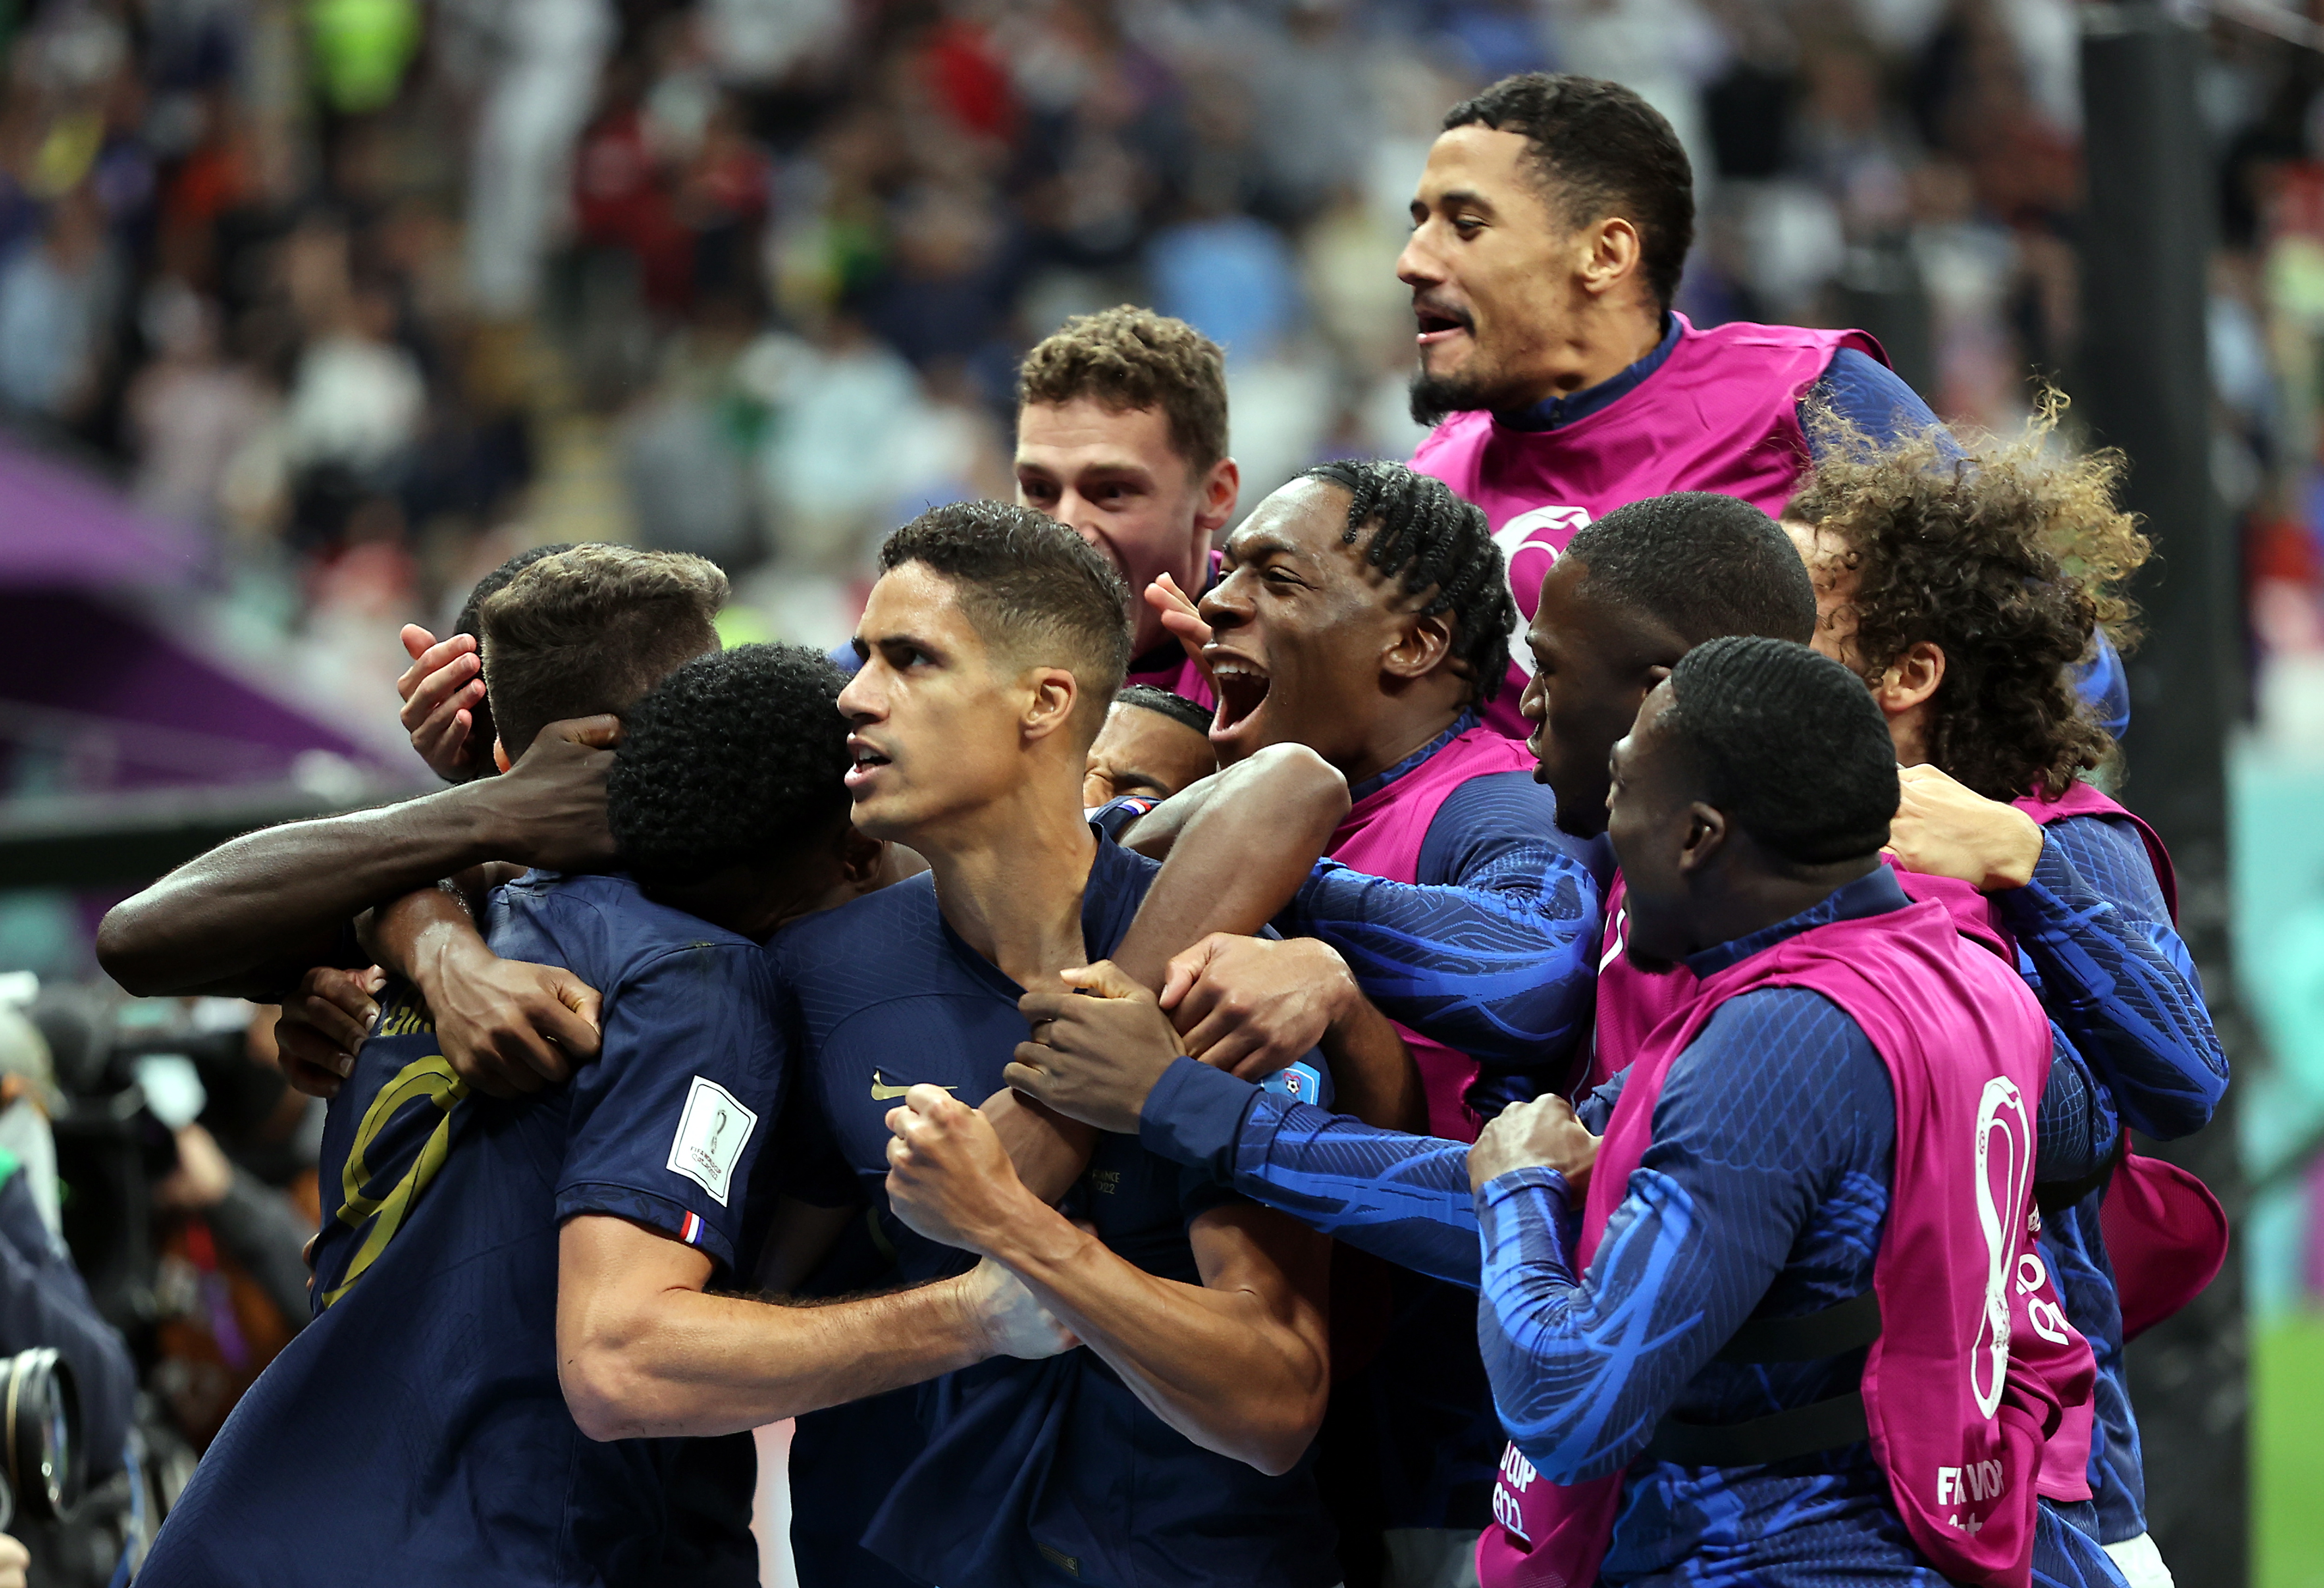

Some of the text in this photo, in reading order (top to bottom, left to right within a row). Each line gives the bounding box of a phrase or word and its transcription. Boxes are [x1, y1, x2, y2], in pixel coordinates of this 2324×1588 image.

[690, 1146, 704, 1156] FIFA
[322, 1055, 469, 1309] 9
[1505, 1446, 1538, 1493] CUP
